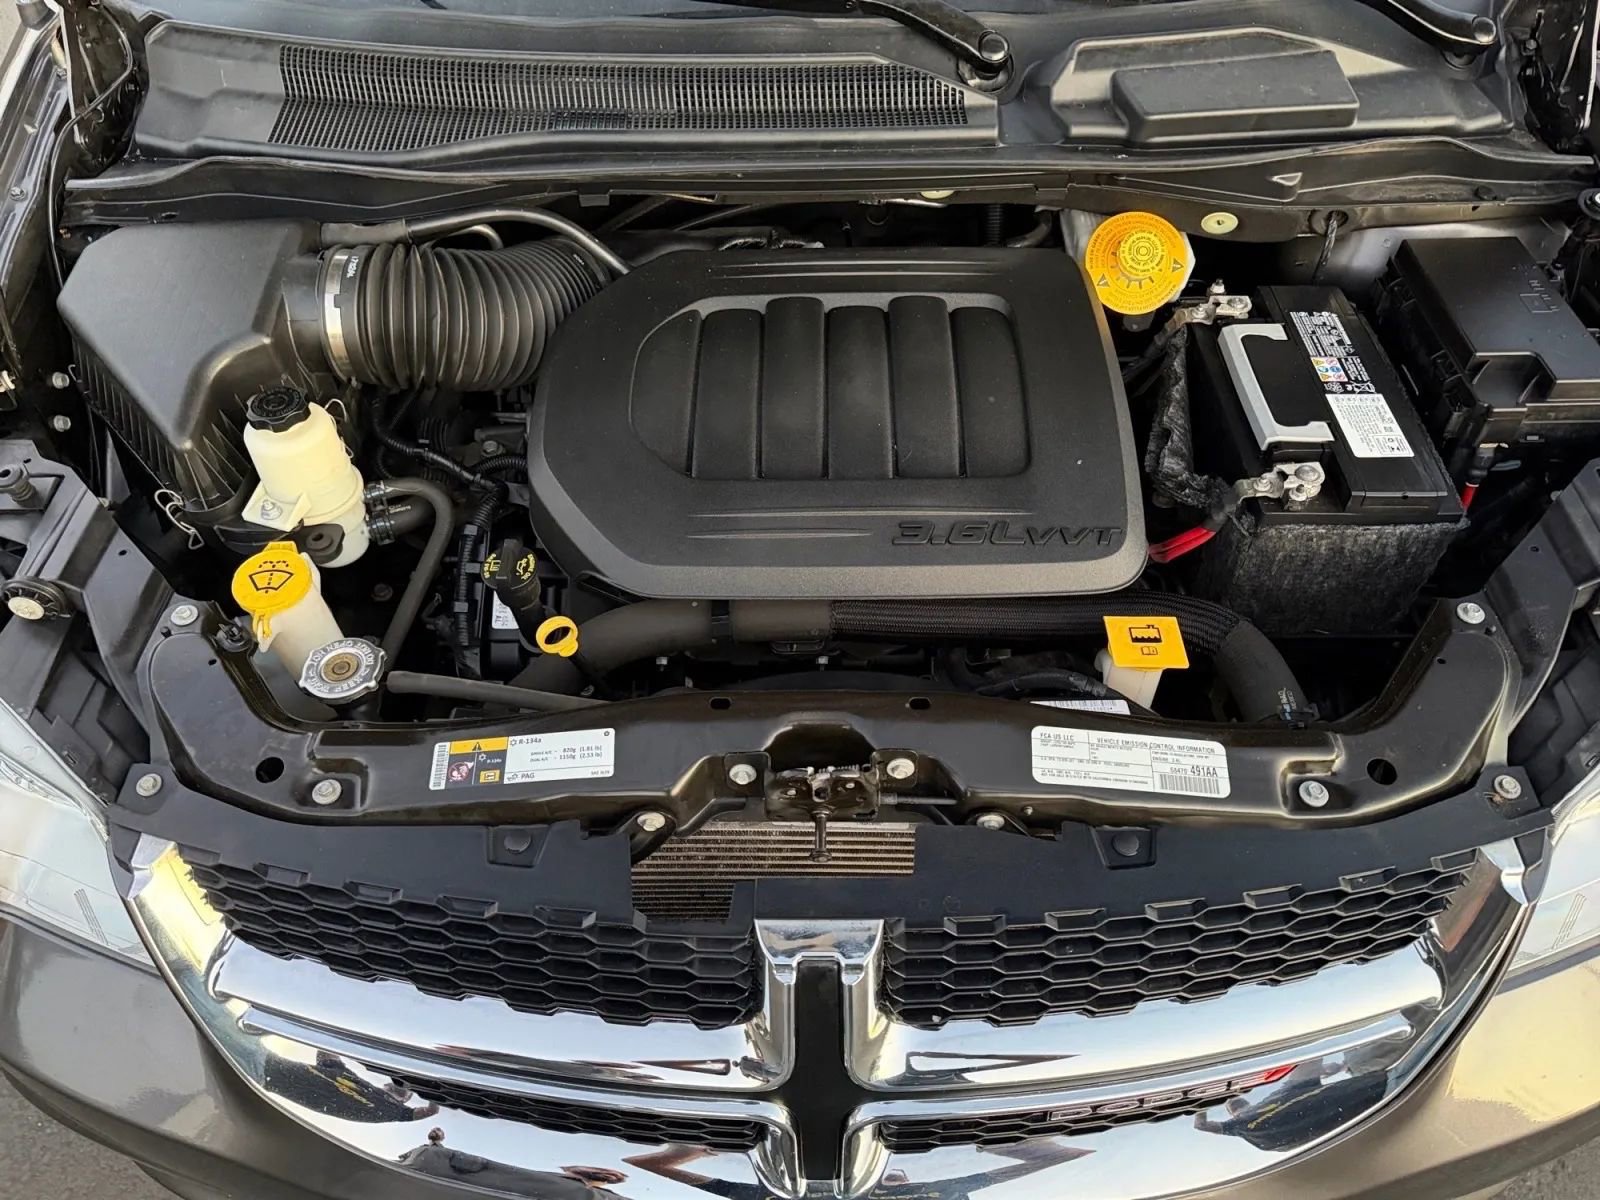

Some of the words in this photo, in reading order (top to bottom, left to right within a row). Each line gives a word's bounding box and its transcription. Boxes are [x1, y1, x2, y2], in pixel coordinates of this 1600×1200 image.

[326, 640, 353, 652] OPEN
[518, 737, 542, 745] R-134a
[1097, 737, 1119, 745] VEHICLE
[1121, 740, 1148, 748] EMISSION
[1150, 742, 1175, 750] CONTROL
[1176, 745, 1215, 754] INFORMATION
[1190, 765, 1218, 777] 491AA
